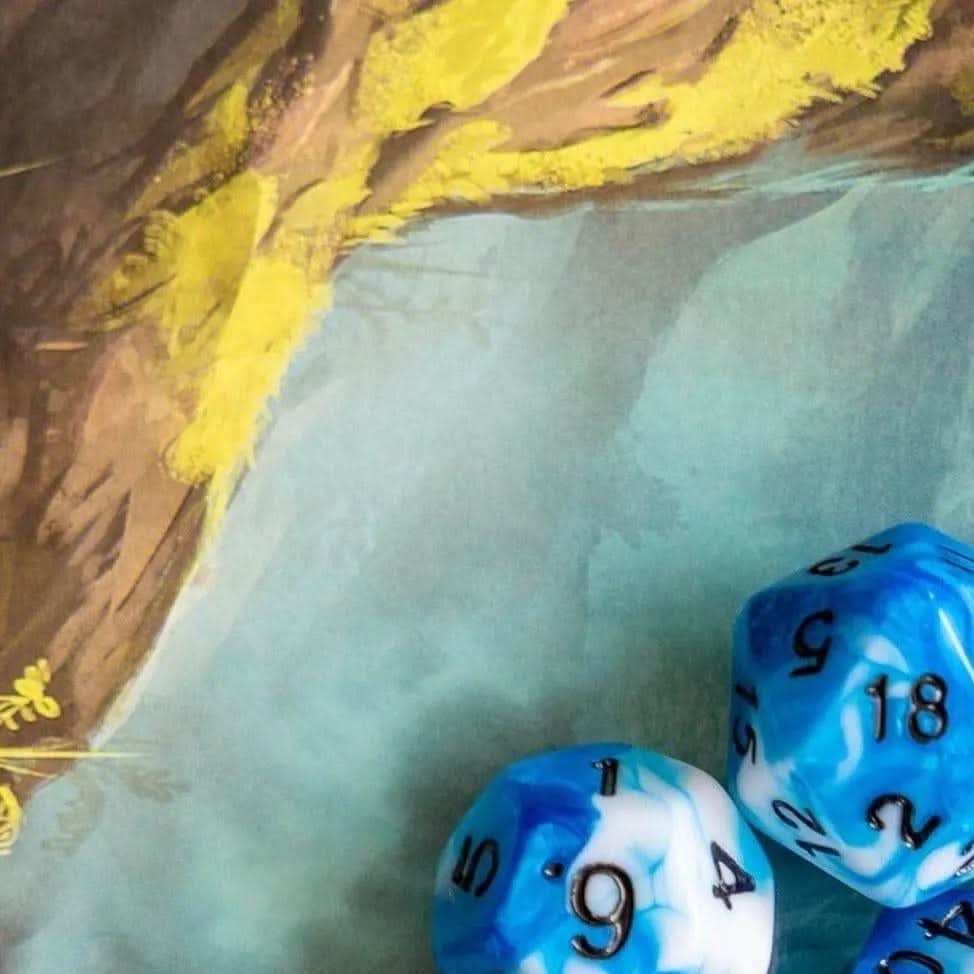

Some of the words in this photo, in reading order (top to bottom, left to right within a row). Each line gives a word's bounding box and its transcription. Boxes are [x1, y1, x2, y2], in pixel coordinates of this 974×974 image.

[788, 608, 834, 678] 5
[865, 672, 948, 743] 18
[590, 757, 619, 797] 1
[770, 799, 841, 858] 12
[865, 792, 942, 850] 2
[451, 835, 500, 897] 5
[710, 841, 757, 911] 4
